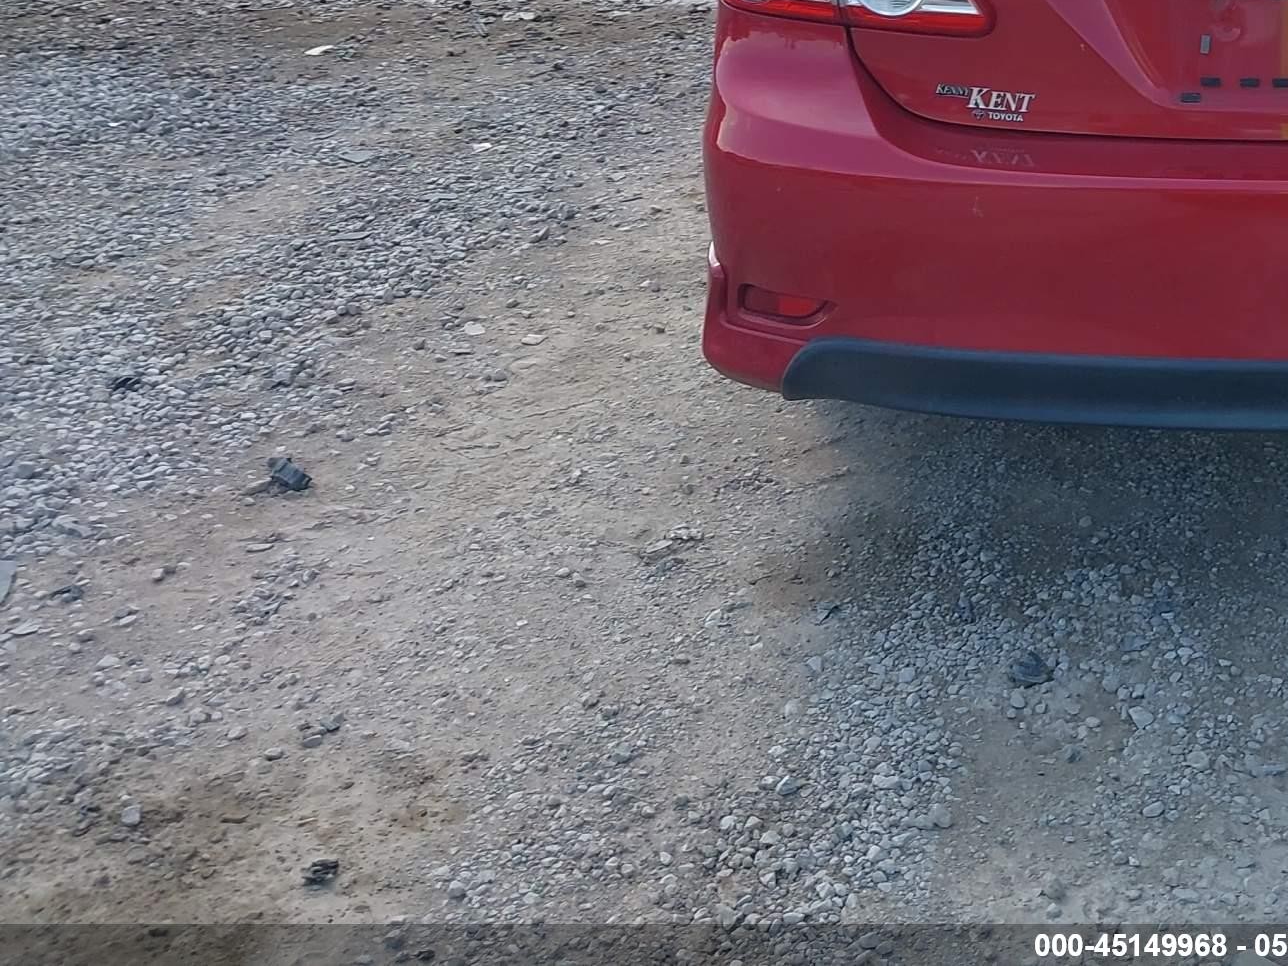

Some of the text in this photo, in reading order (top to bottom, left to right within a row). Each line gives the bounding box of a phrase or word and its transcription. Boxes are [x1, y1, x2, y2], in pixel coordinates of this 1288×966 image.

[936, 84, 1036, 113] KENNY KENT
[988, 111, 1024, 122] TOYOTA
